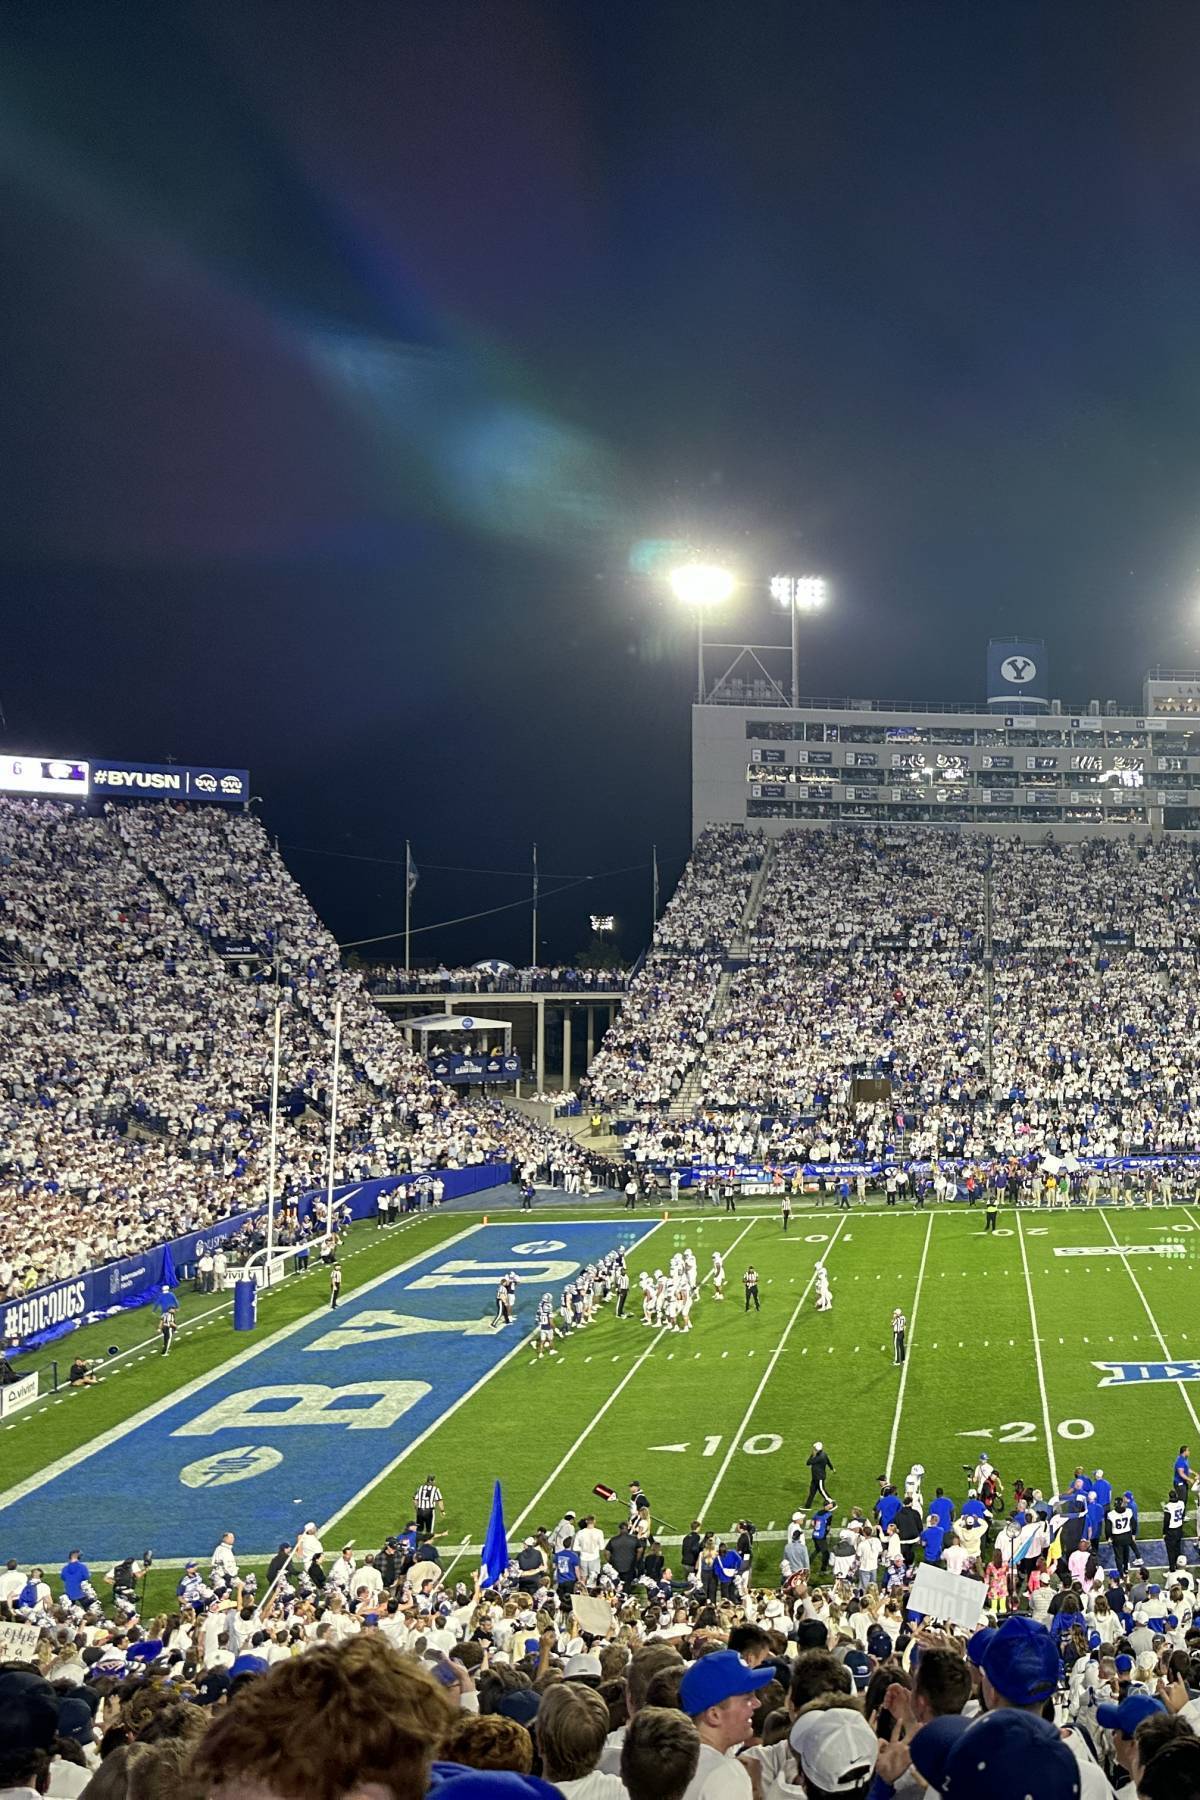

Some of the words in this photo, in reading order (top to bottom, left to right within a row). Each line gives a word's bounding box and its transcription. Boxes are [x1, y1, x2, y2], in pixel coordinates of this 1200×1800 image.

[1006, 659, 1031, 680] Y
[93, 769, 181, 789] #BYUSN
[699, 1168, 716, 1176] GO
[816, 1165, 832, 1173] GO
[833, 1165, 873, 1173] COUGS
[4, 1281, 86, 1338] #GOCOUGS
[169, 1260, 581, 1437] BYU
[16, 1379, 36, 1400] vivint
[999, 1418, 1096, 1444] 20
[702, 1432, 784, 1457] 10
[1115, 1516, 1129, 1531] 67
